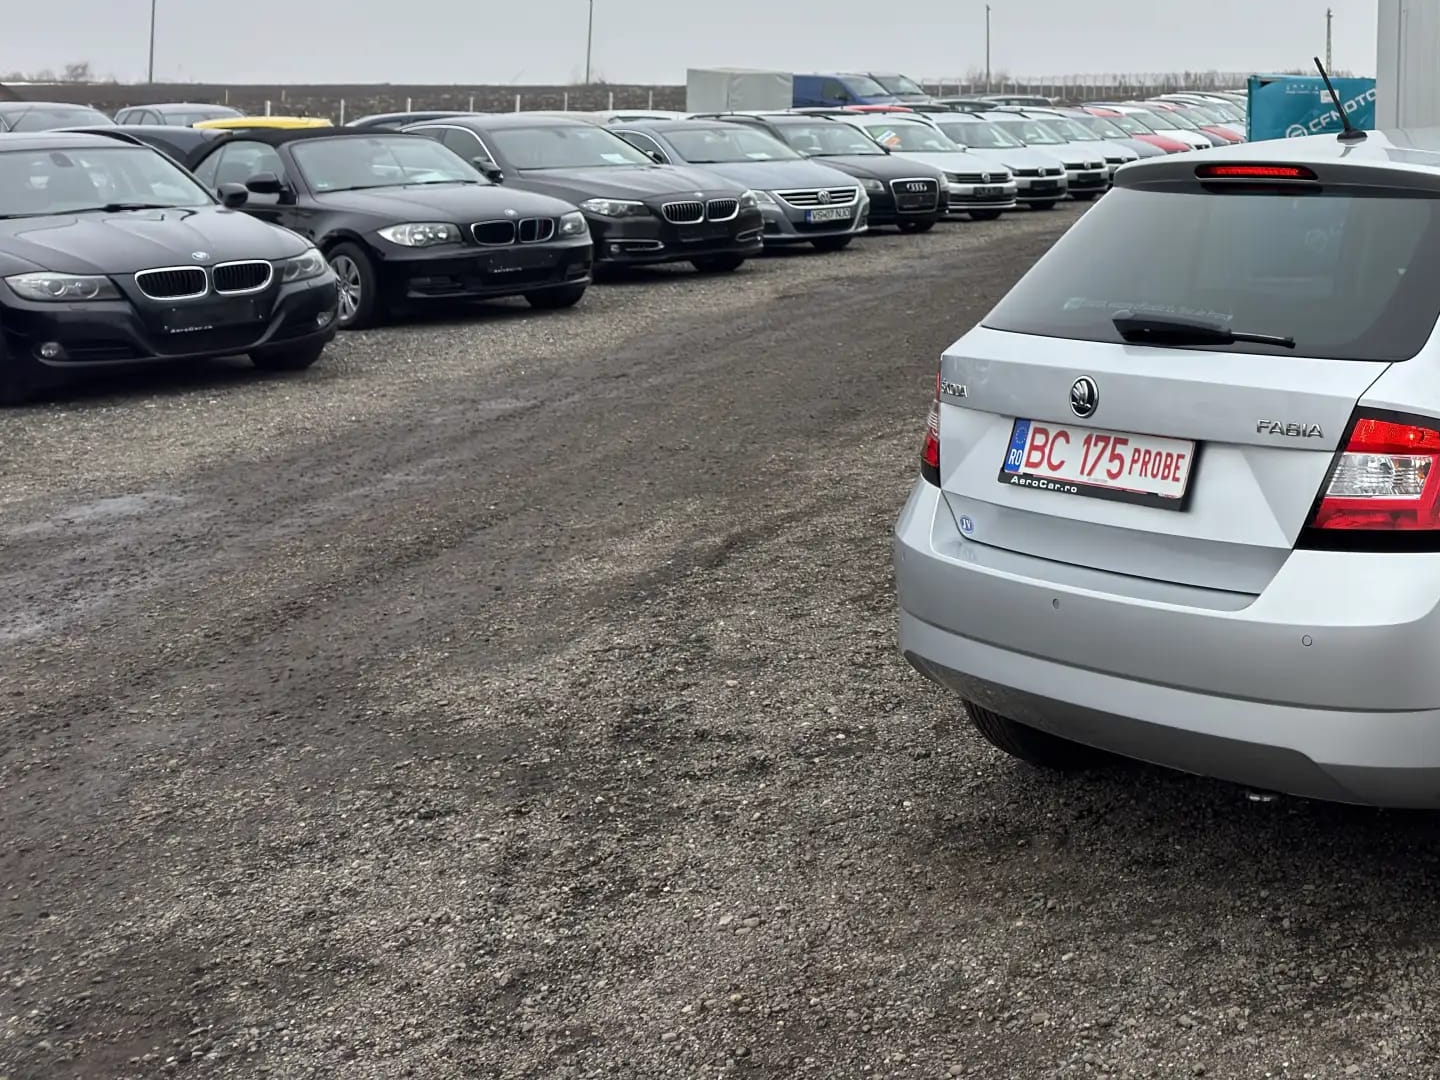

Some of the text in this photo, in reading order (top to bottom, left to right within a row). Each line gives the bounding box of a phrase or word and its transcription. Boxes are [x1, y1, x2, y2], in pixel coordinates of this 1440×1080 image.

[1256, 419, 1325, 438] FABIA
[1008, 448, 1022, 466] RO
[1024, 426, 1186, 483] BC 175 PROBE
[1010, 475, 1078, 494] AeroCar.ro
